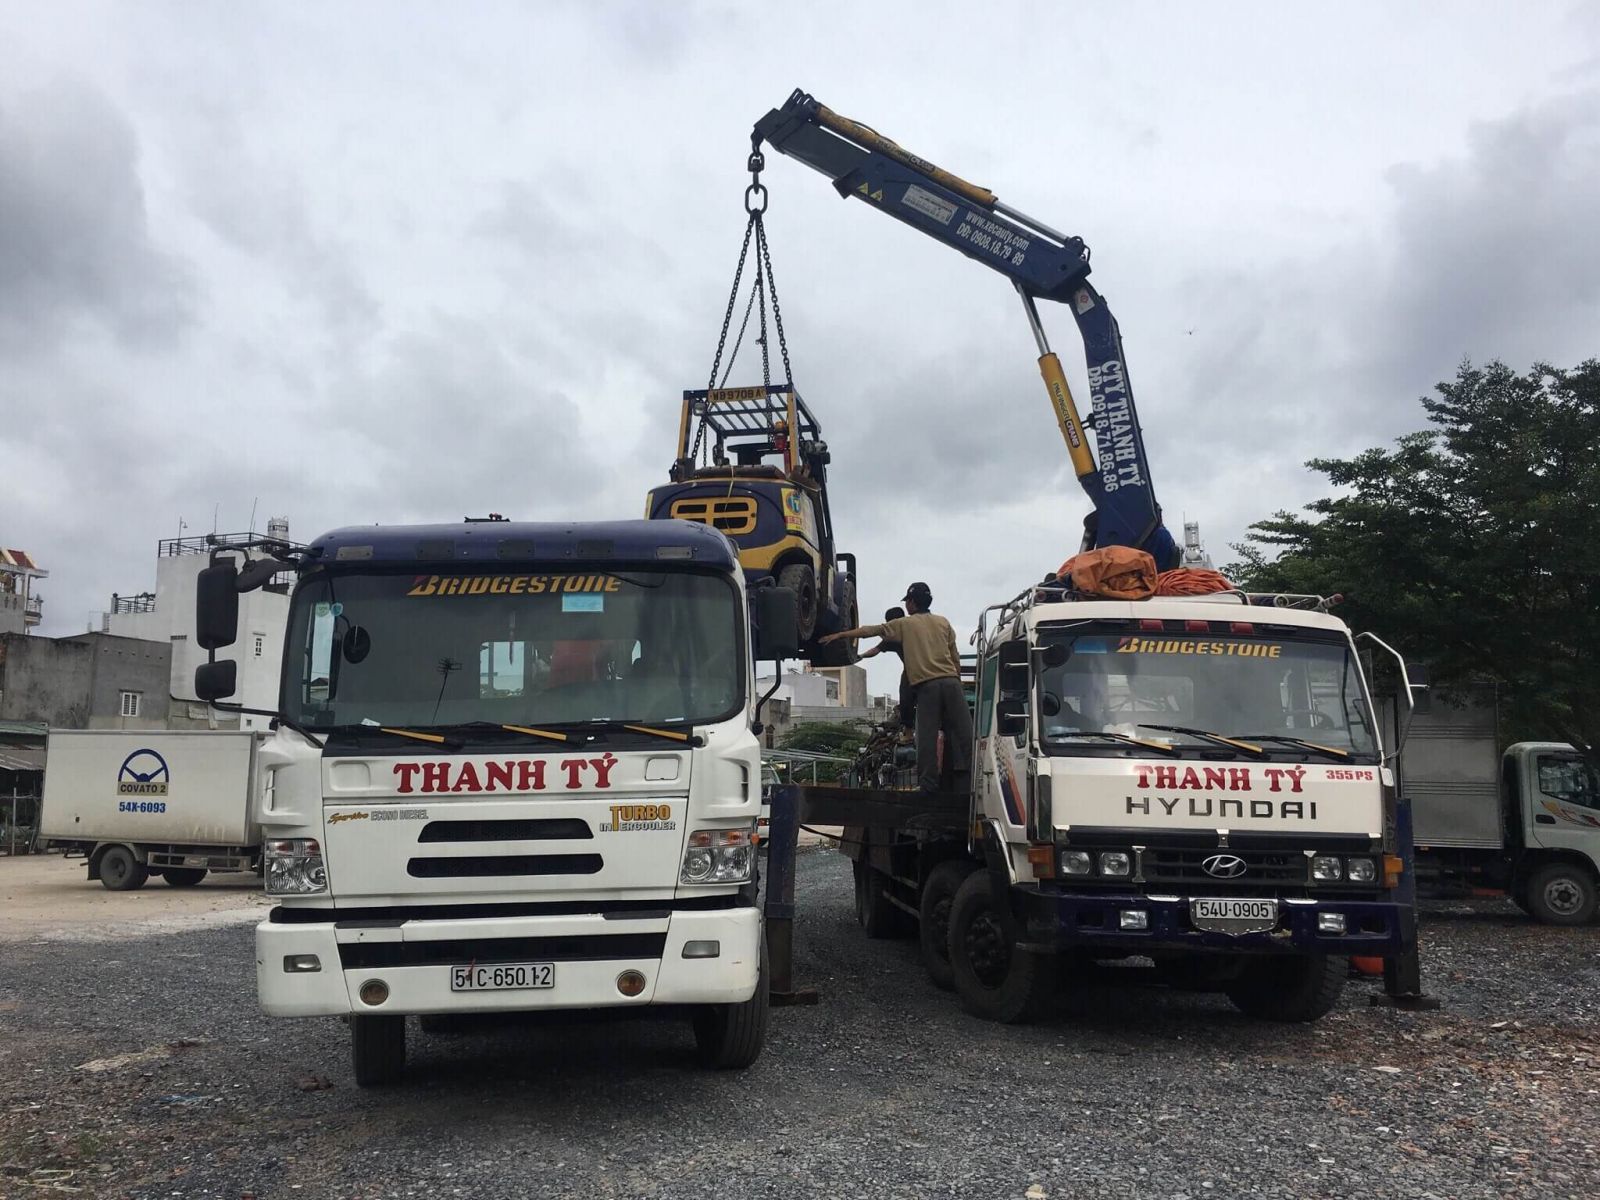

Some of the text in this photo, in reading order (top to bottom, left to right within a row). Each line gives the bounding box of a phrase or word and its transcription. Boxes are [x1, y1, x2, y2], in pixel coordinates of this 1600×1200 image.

[1011, 252, 1025, 266] 89
[1065, 420, 1079, 447] CRANE
[1101, 360, 1146, 487] CTY THANH TÝ
[1092, 394, 1119, 492] 0918.71.86.86
[406, 575, 624, 596] BRIDGESTONE
[1116, 637, 1282, 659] BRIDGESTONE
[393, 752, 618, 793] THANH TÝ
[1134, 765, 1307, 793] THANH TÝ
[120, 784, 166, 793] COVATO 2
[119, 801, 166, 813] 54X-6093
[609, 804, 671, 832] TURBO
[1126, 796, 1317, 820] HYUNDAI
[455, 966, 551, 988] 51C-650.12
